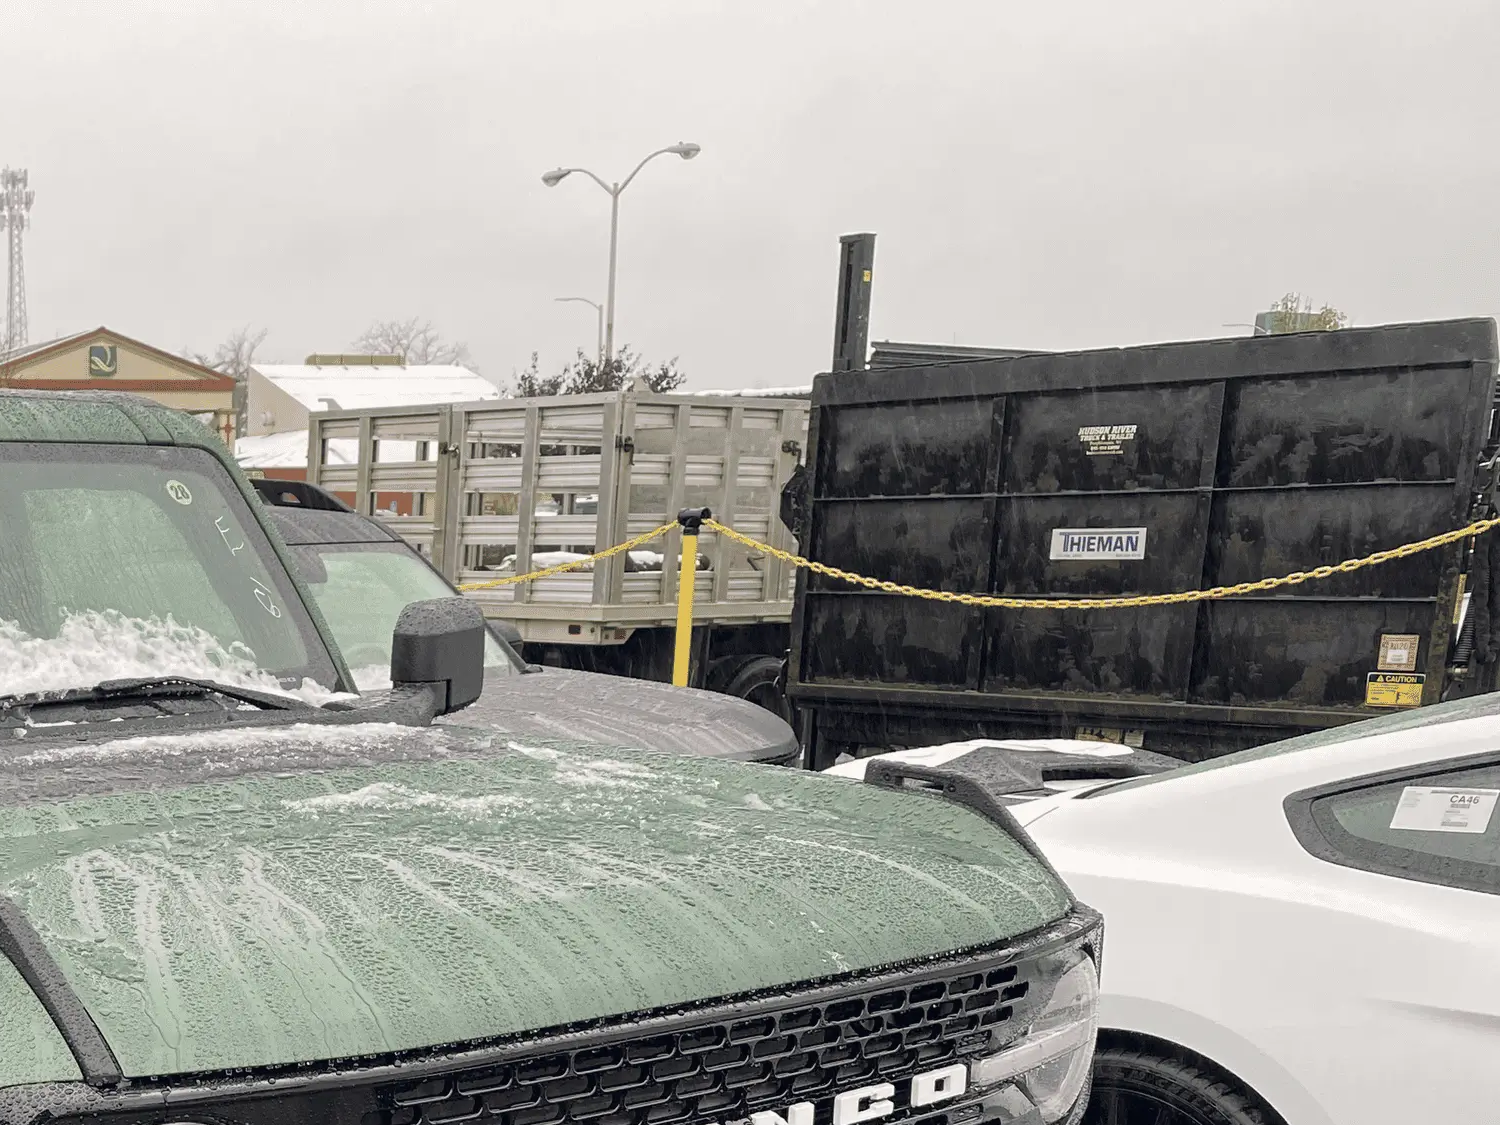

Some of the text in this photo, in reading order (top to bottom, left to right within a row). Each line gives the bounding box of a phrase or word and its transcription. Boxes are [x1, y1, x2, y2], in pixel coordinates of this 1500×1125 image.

[1078, 425, 1137, 435] HUDSON RIVER
[169, 484, 190, 501] 28
[1059, 531, 1140, 553] THIEMAN
[1385, 675, 1418, 684] CAUTION
[1449, 795, 1481, 805] CA46
